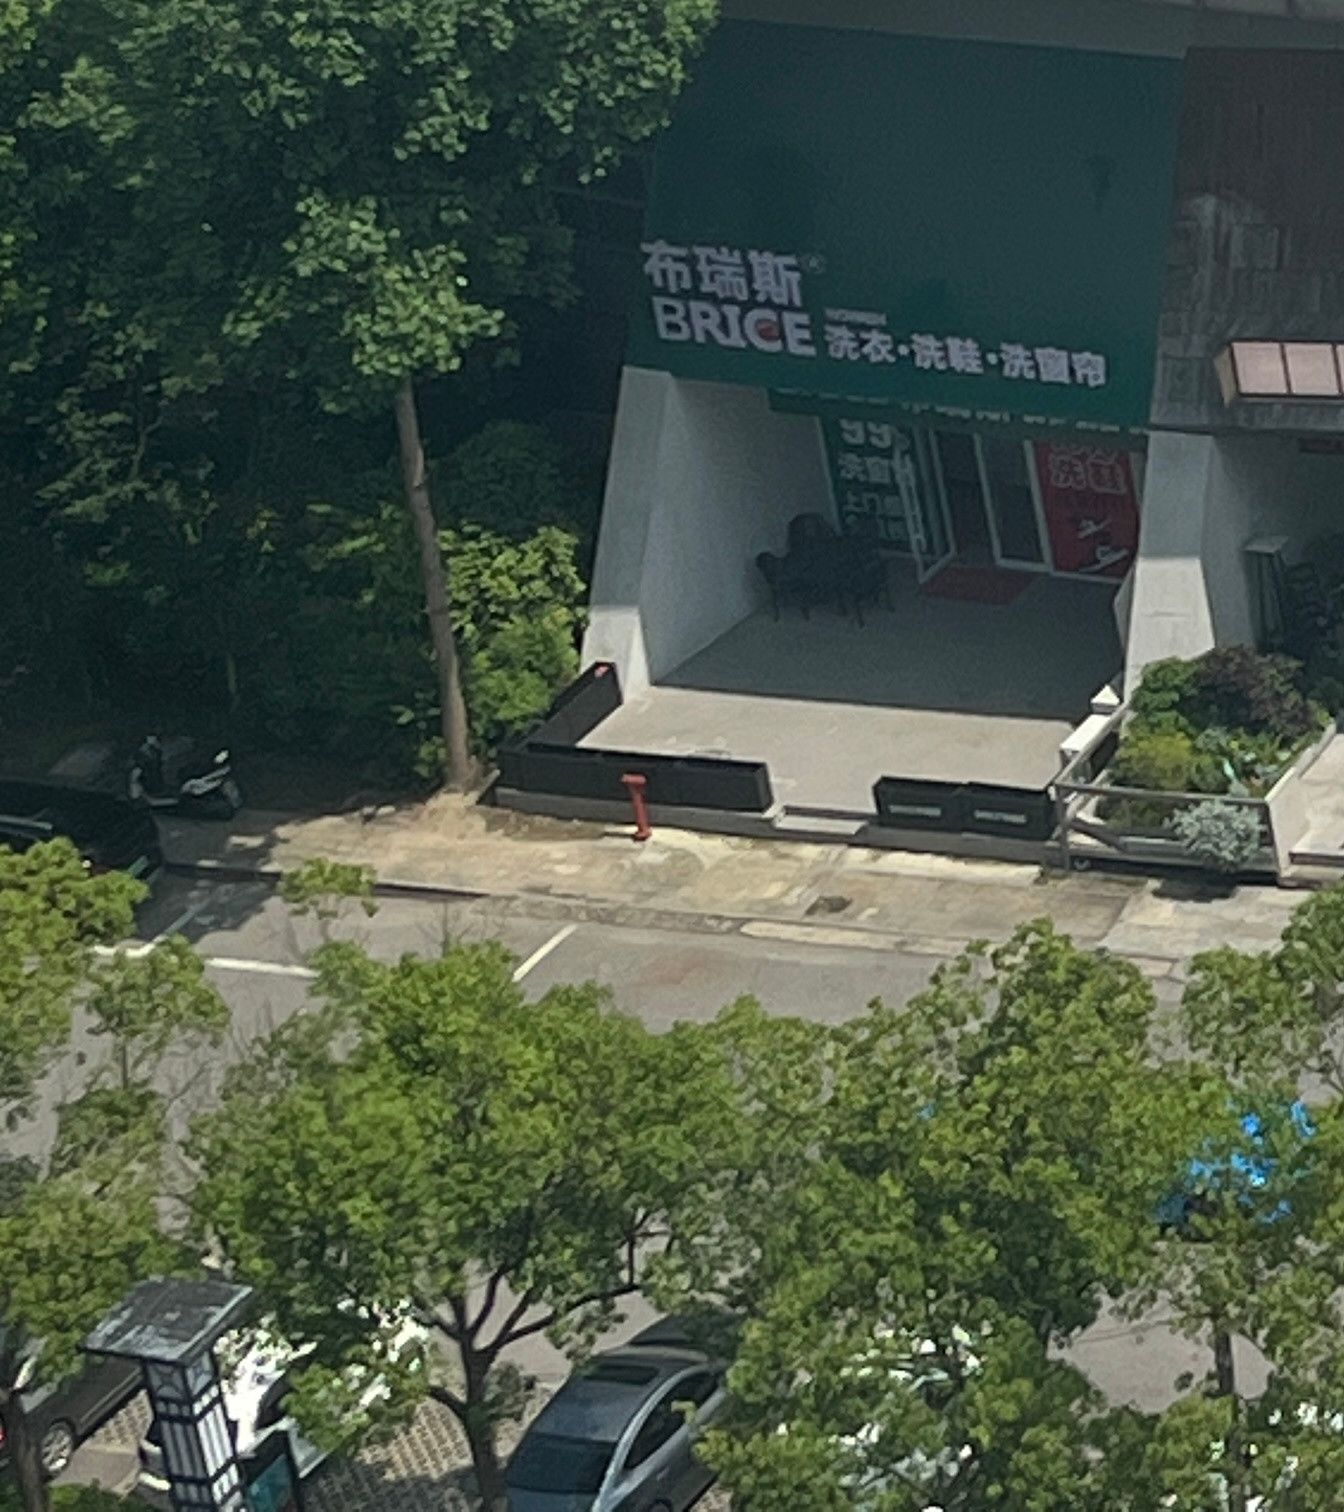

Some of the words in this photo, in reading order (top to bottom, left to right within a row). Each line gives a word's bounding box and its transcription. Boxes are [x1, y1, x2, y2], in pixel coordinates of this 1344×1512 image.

[640, 239, 803, 308] 布瑞斯
[652, 294, 817, 357] BRICE
